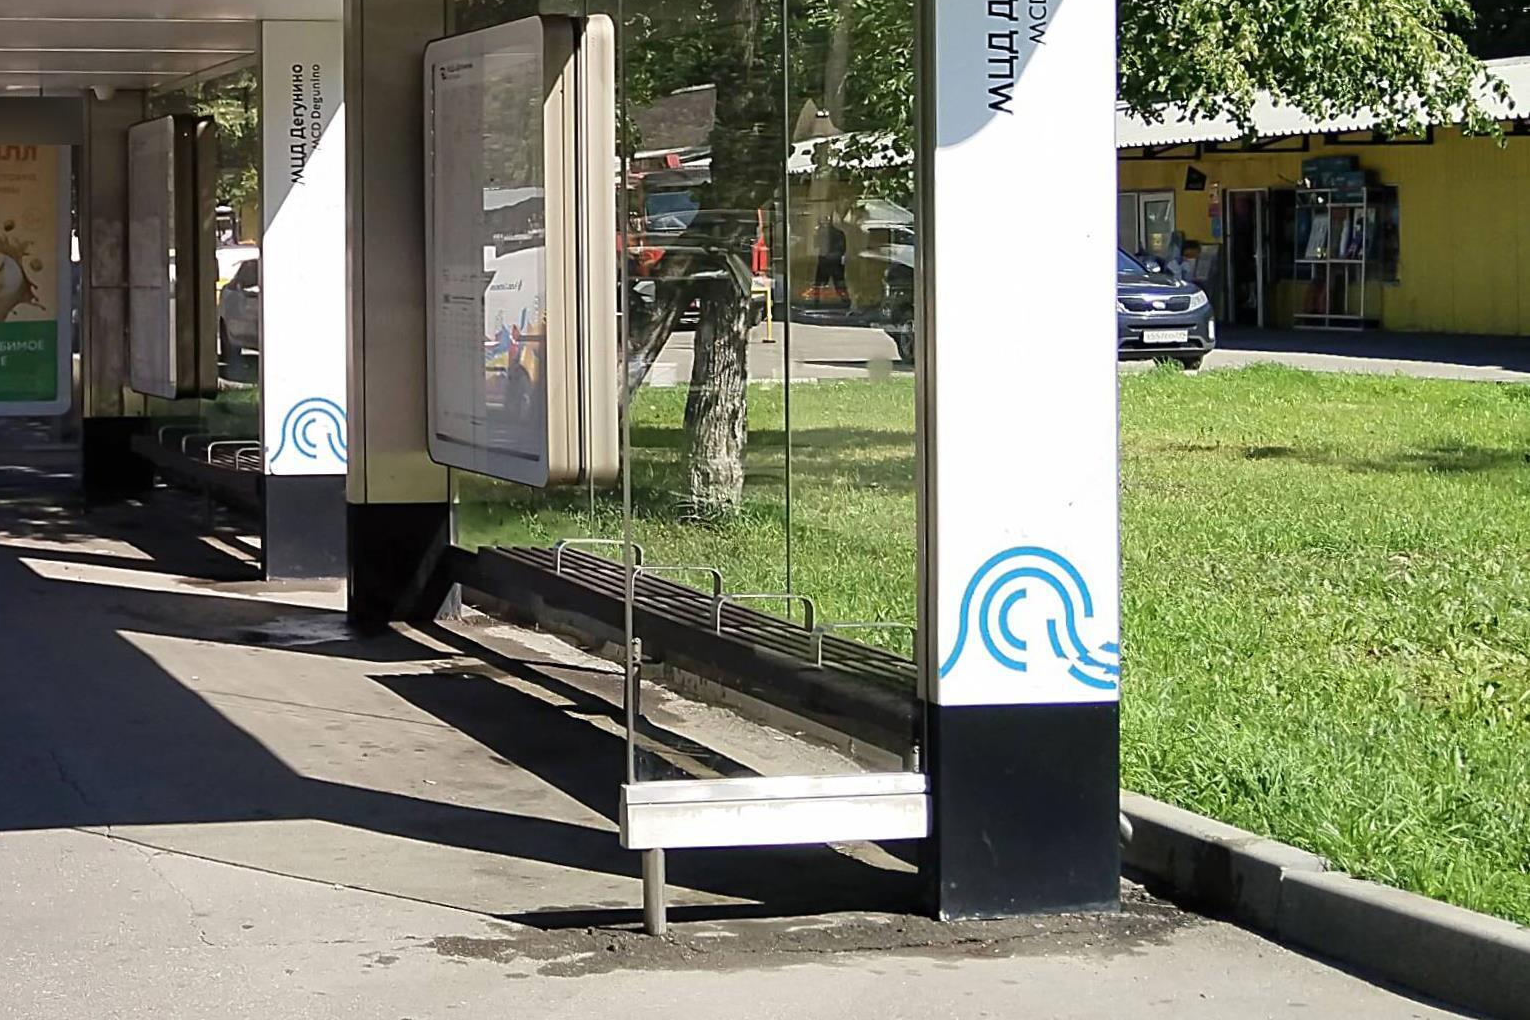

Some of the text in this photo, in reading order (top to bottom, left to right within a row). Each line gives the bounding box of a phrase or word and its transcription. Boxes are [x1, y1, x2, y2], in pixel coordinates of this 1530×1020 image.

[310, 63, 323, 151] MCD Degunino
[987, 30, 1019, 115] МЦД
[291, 64, 308, 186] МЦД Дегунино
